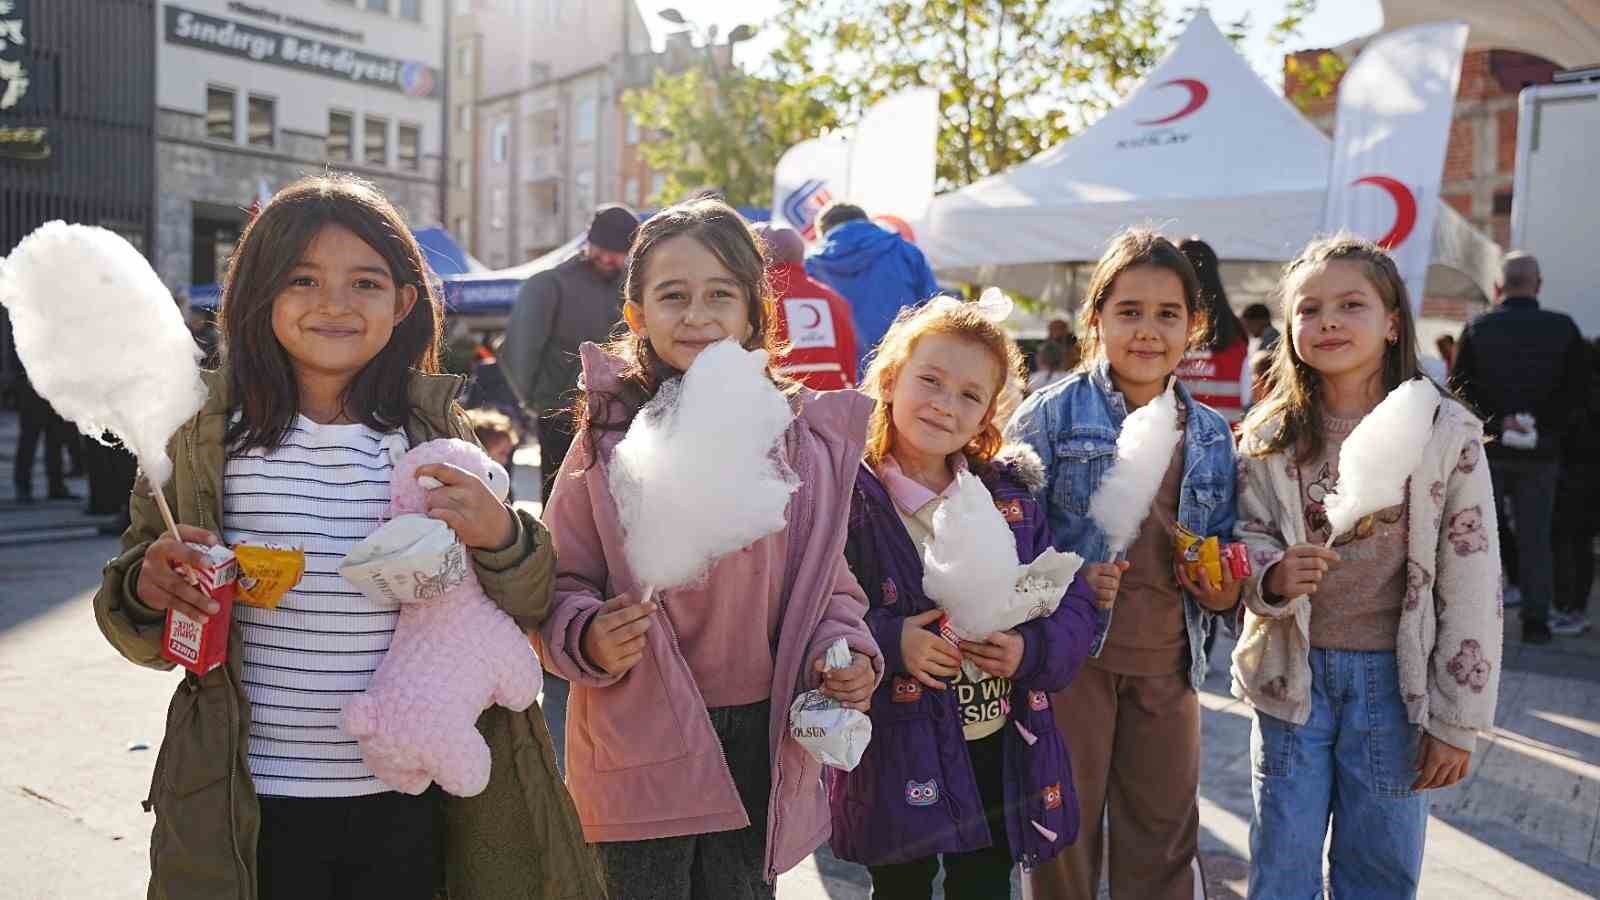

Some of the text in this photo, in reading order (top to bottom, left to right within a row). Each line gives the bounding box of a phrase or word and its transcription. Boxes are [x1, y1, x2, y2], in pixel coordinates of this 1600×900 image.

[174, 11, 275, 60] Sındırgı
[280, 38, 397, 81] Belediyesi
[794, 727, 828, 738] OLSUN
